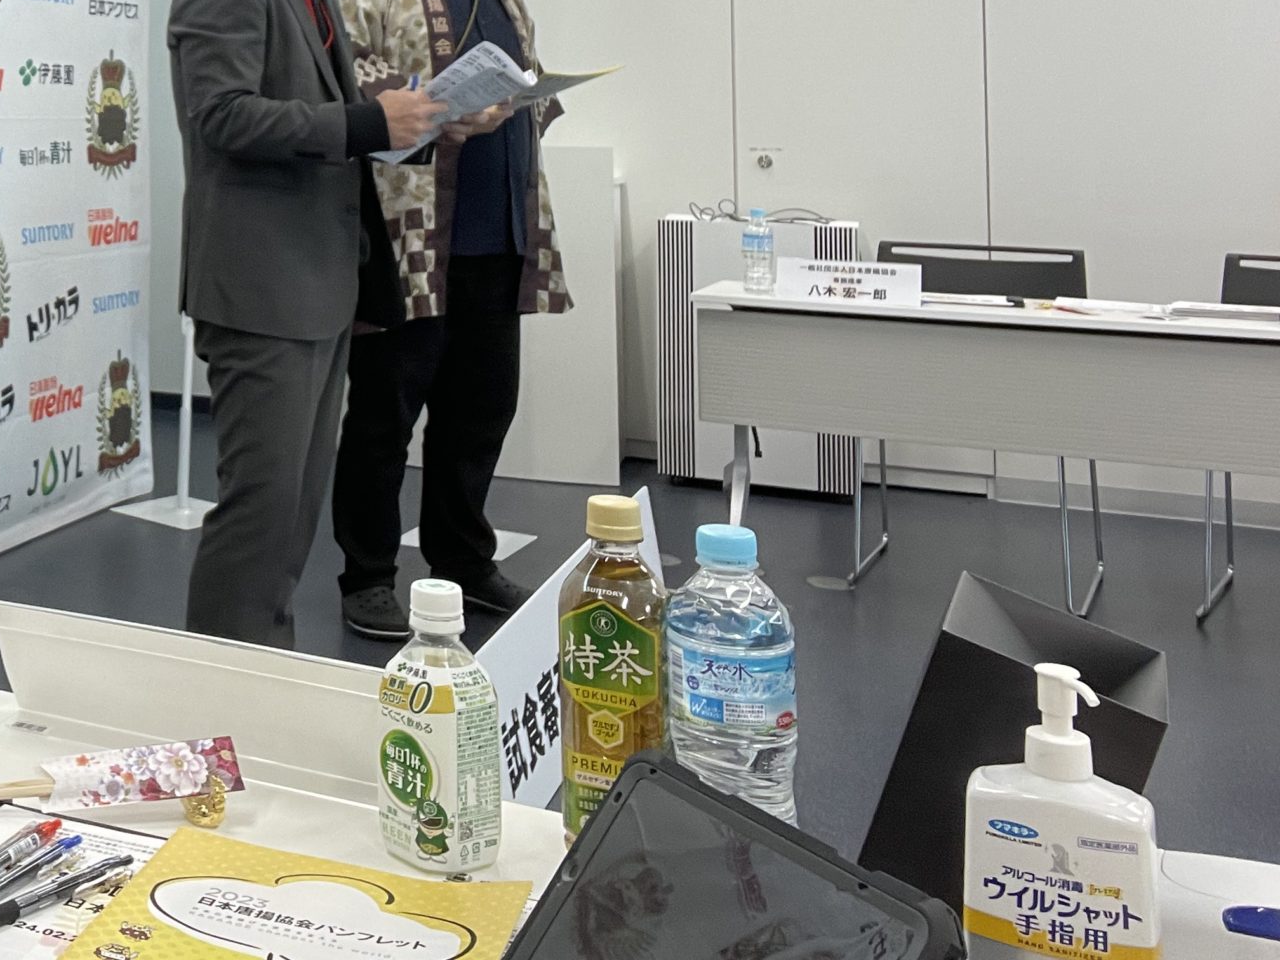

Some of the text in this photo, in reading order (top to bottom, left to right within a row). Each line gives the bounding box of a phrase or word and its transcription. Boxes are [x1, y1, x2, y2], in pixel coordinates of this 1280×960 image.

[38, 62, 75, 86] 伊藤園
[21, 223, 75, 246] SUNTORY
[92, 290, 140, 314] SUNTORY
[808, 284, 837, 297] 八木
[563, 630, 654, 688] 特茶
[382, 690, 407, 704] カロリー
[408, 681, 433, 715] 0
[574, 687, 638, 708] TOKUCHA
[500, 656, 561, 800] 試食審
[571, 755, 624, 776] PREMI
[385, 759, 426, 799] 青汁
[1001, 865, 1084, 893] アルコール消毒
[204, 887, 270, 909] 2023
[983, 876, 1143, 930] ウイルシャット
[197, 895, 427, 950] 日本唐揚協会パンフレット
[1014, 913, 1109, 953] 手指用
